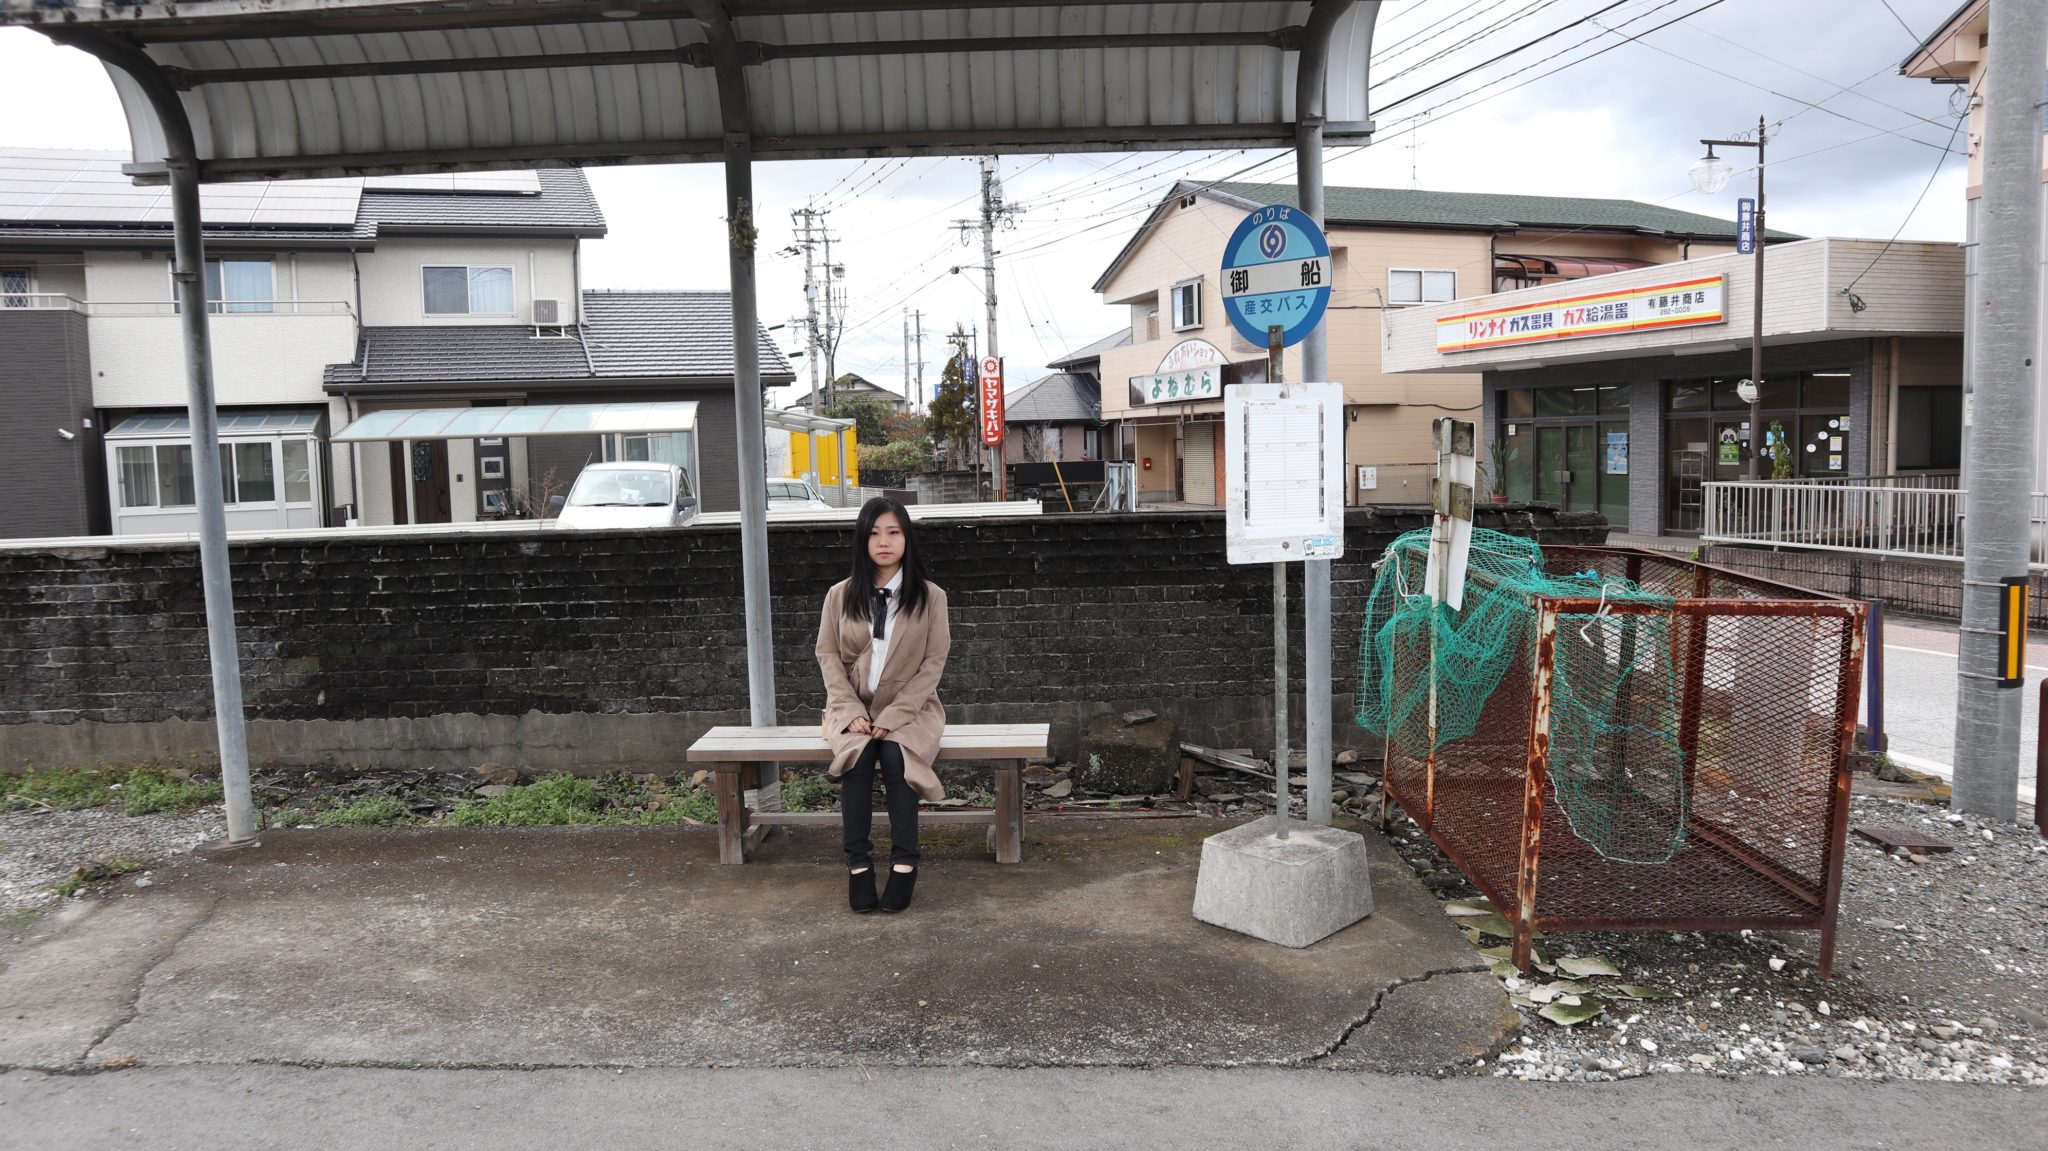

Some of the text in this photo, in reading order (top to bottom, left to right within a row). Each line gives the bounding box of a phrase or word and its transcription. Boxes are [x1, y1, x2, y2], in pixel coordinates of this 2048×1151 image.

[1252, 207, 1290, 225] のりば
[1230, 260, 1321, 294] 御船
[1244, 295, 1308, 316] 産交バス
[985, 378, 999, 442] ヤマザキパン
